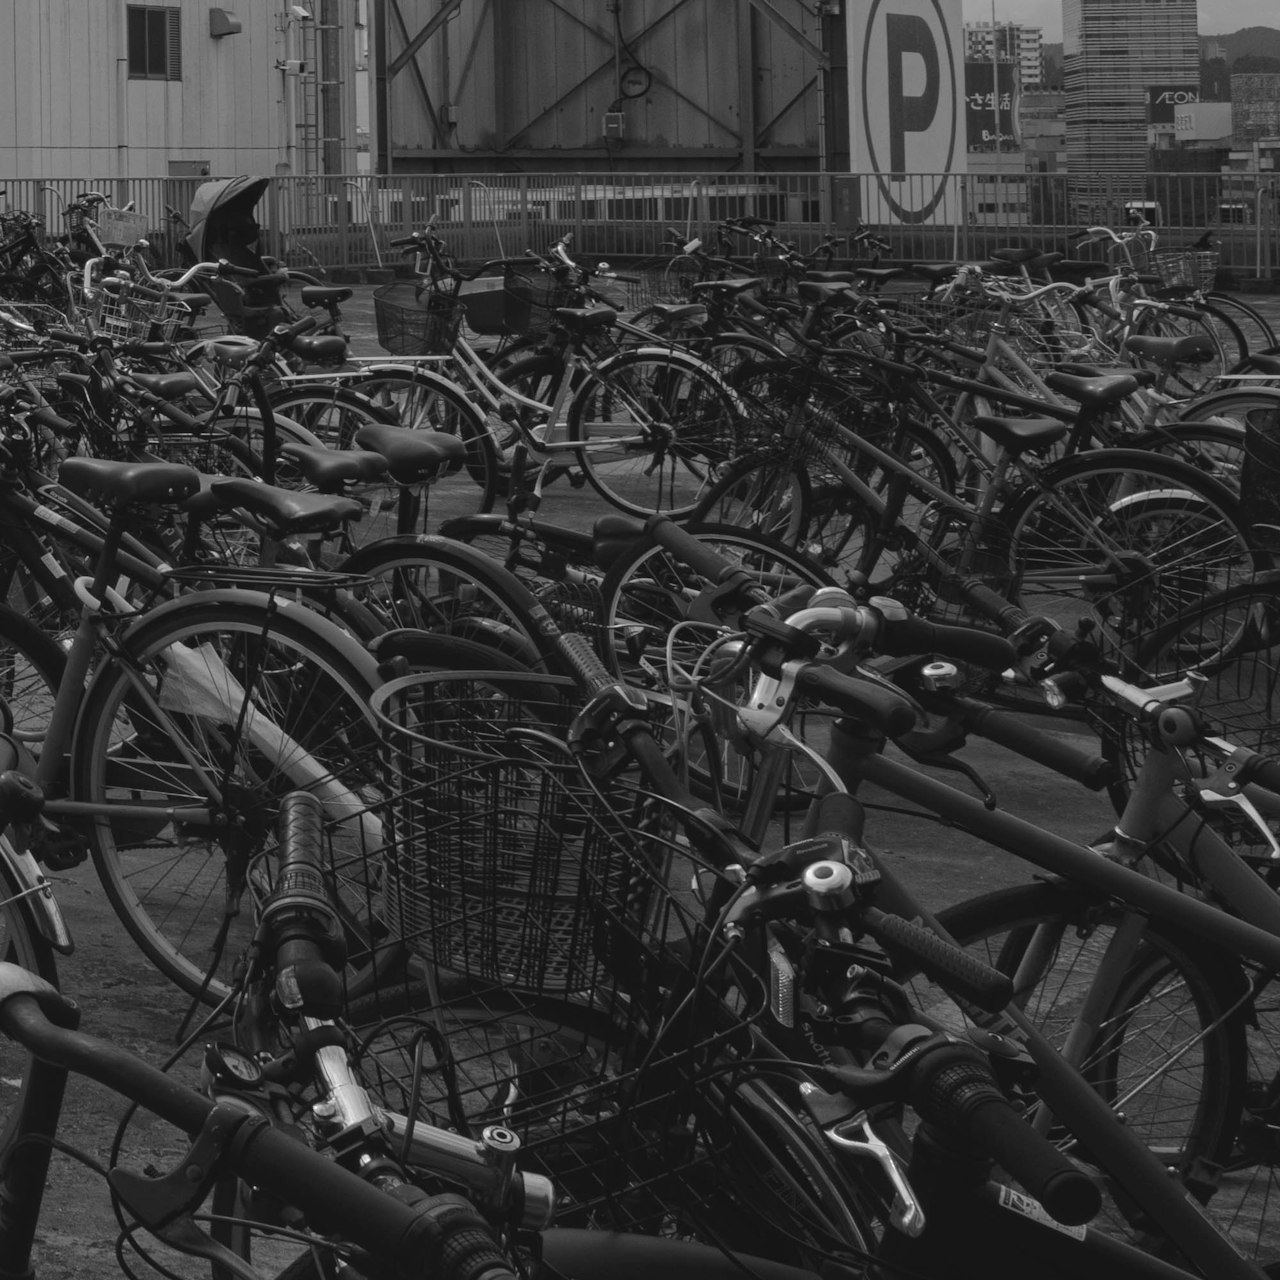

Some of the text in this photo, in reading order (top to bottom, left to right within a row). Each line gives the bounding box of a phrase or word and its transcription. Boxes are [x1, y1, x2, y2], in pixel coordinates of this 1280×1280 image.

[886, 13, 940, 183] P
[964, 92, 1011, 110] さ生活
